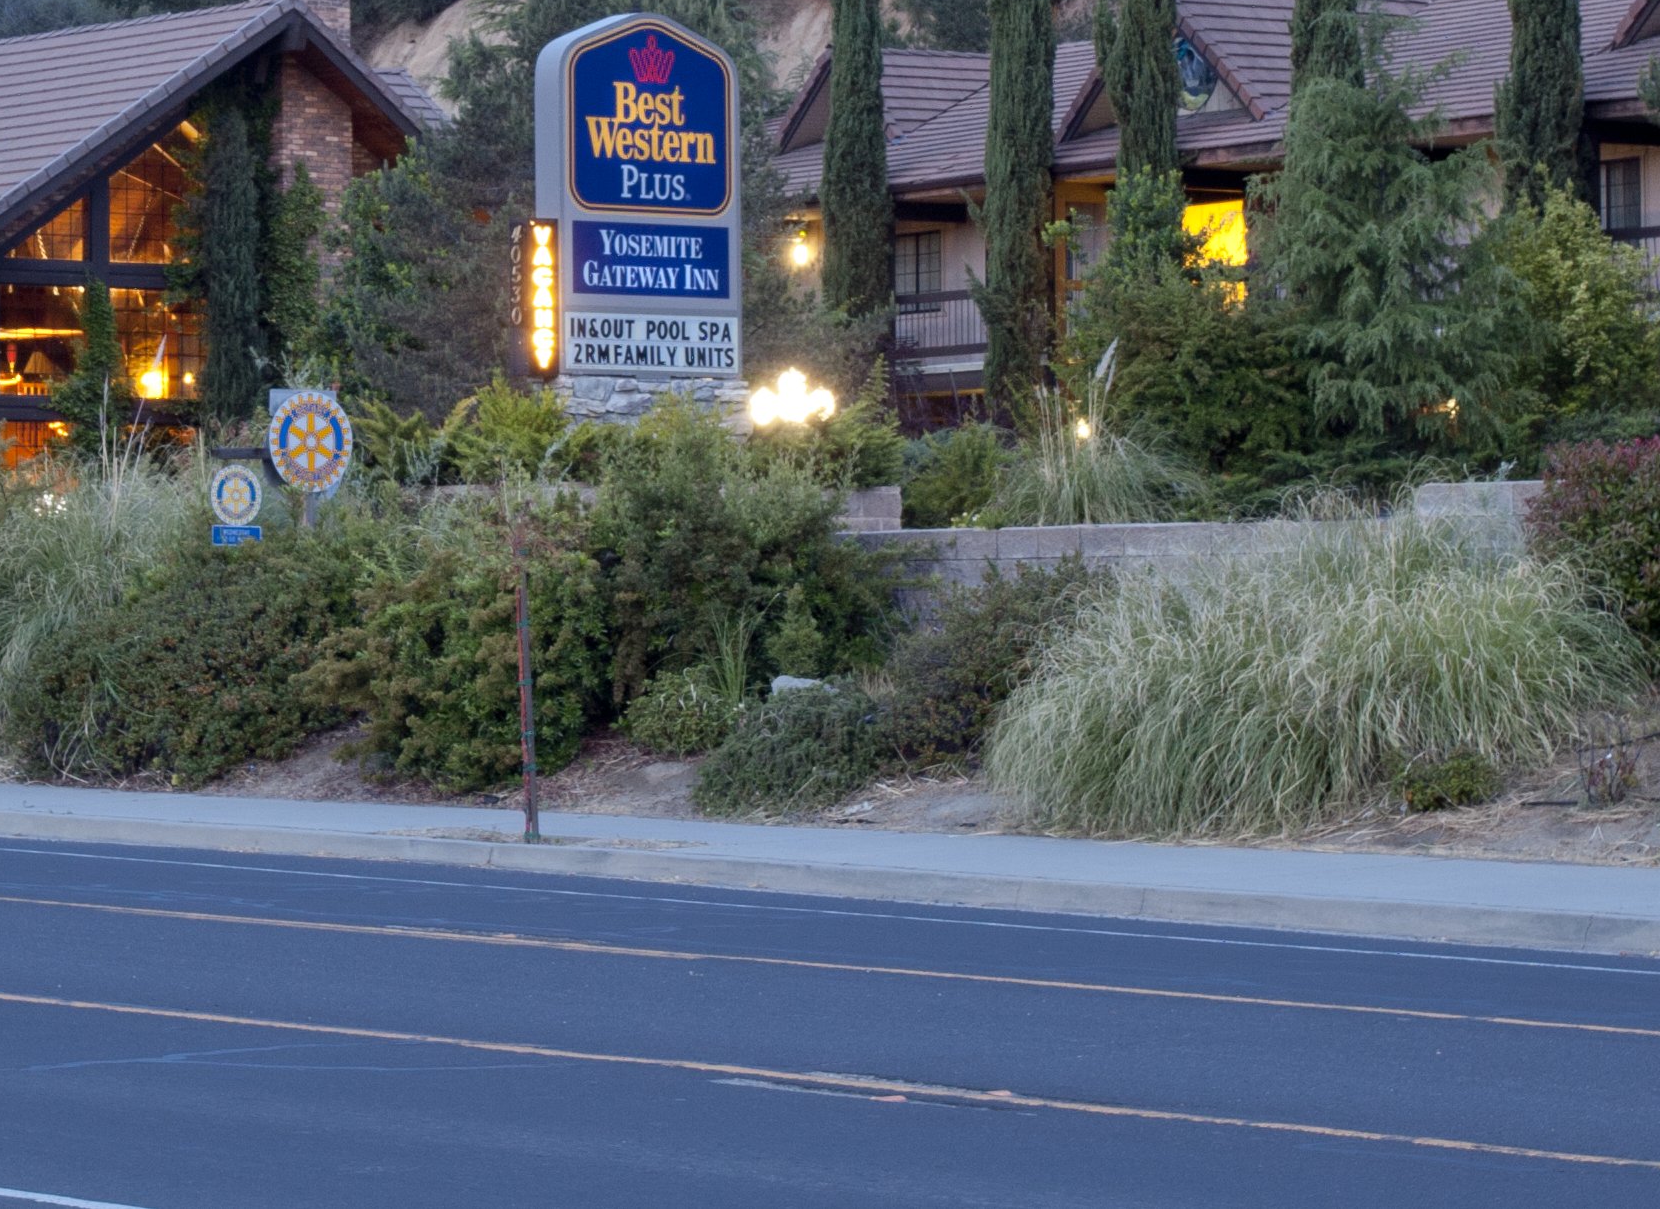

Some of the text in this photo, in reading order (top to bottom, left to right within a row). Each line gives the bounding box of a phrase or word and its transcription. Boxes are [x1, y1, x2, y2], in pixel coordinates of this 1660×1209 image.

[613, 81, 685, 126] Best
[585, 113, 716, 164] Western
[620, 164, 685, 201] PLUS
[599, 229, 703, 259] YOSEMITE
[510, 224, 522, 325] 40530
[583, 260, 720, 291] GATEWAY INN
[532, 225, 554, 368] VACANCY
[646, 320, 690, 341] POOL
[698, 321, 732, 342] SPA
[685, 346, 734, 368] UNITS
